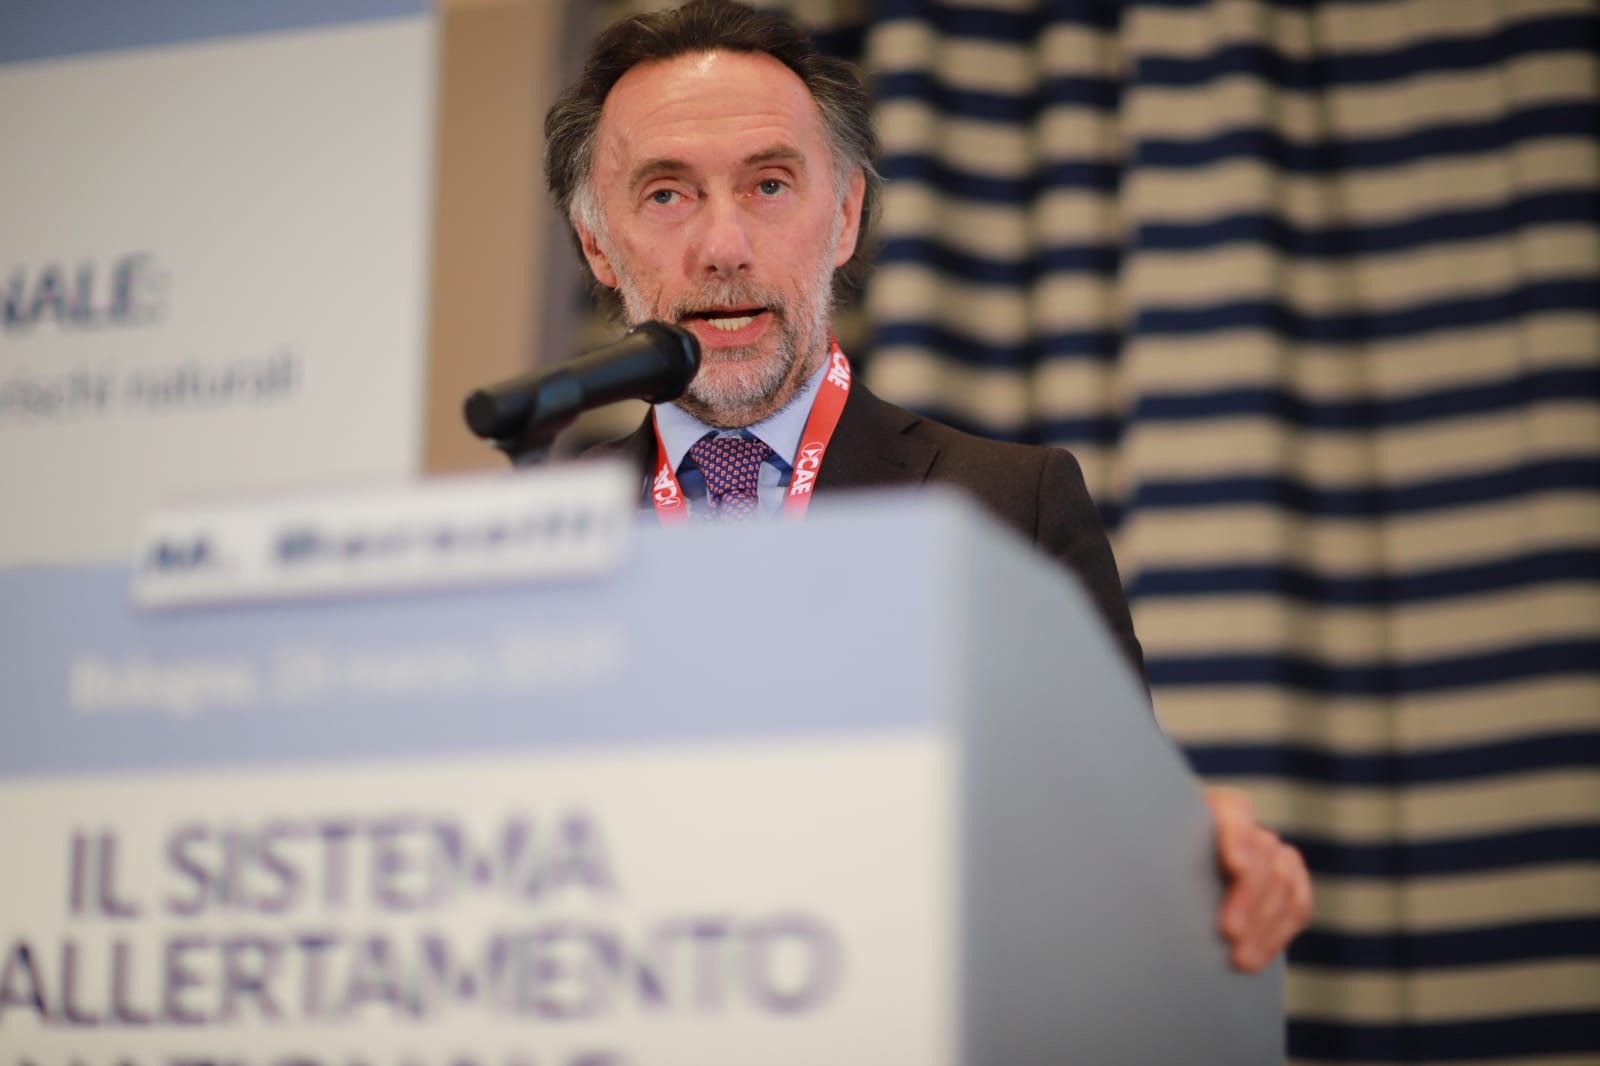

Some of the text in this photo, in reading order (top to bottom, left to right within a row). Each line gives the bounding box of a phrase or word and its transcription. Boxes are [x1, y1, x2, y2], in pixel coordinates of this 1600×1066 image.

[828, 352, 850, 391] CAE
[790, 457, 820, 496] CAE
[67, 812, 618, 918] IL SISTEMA
